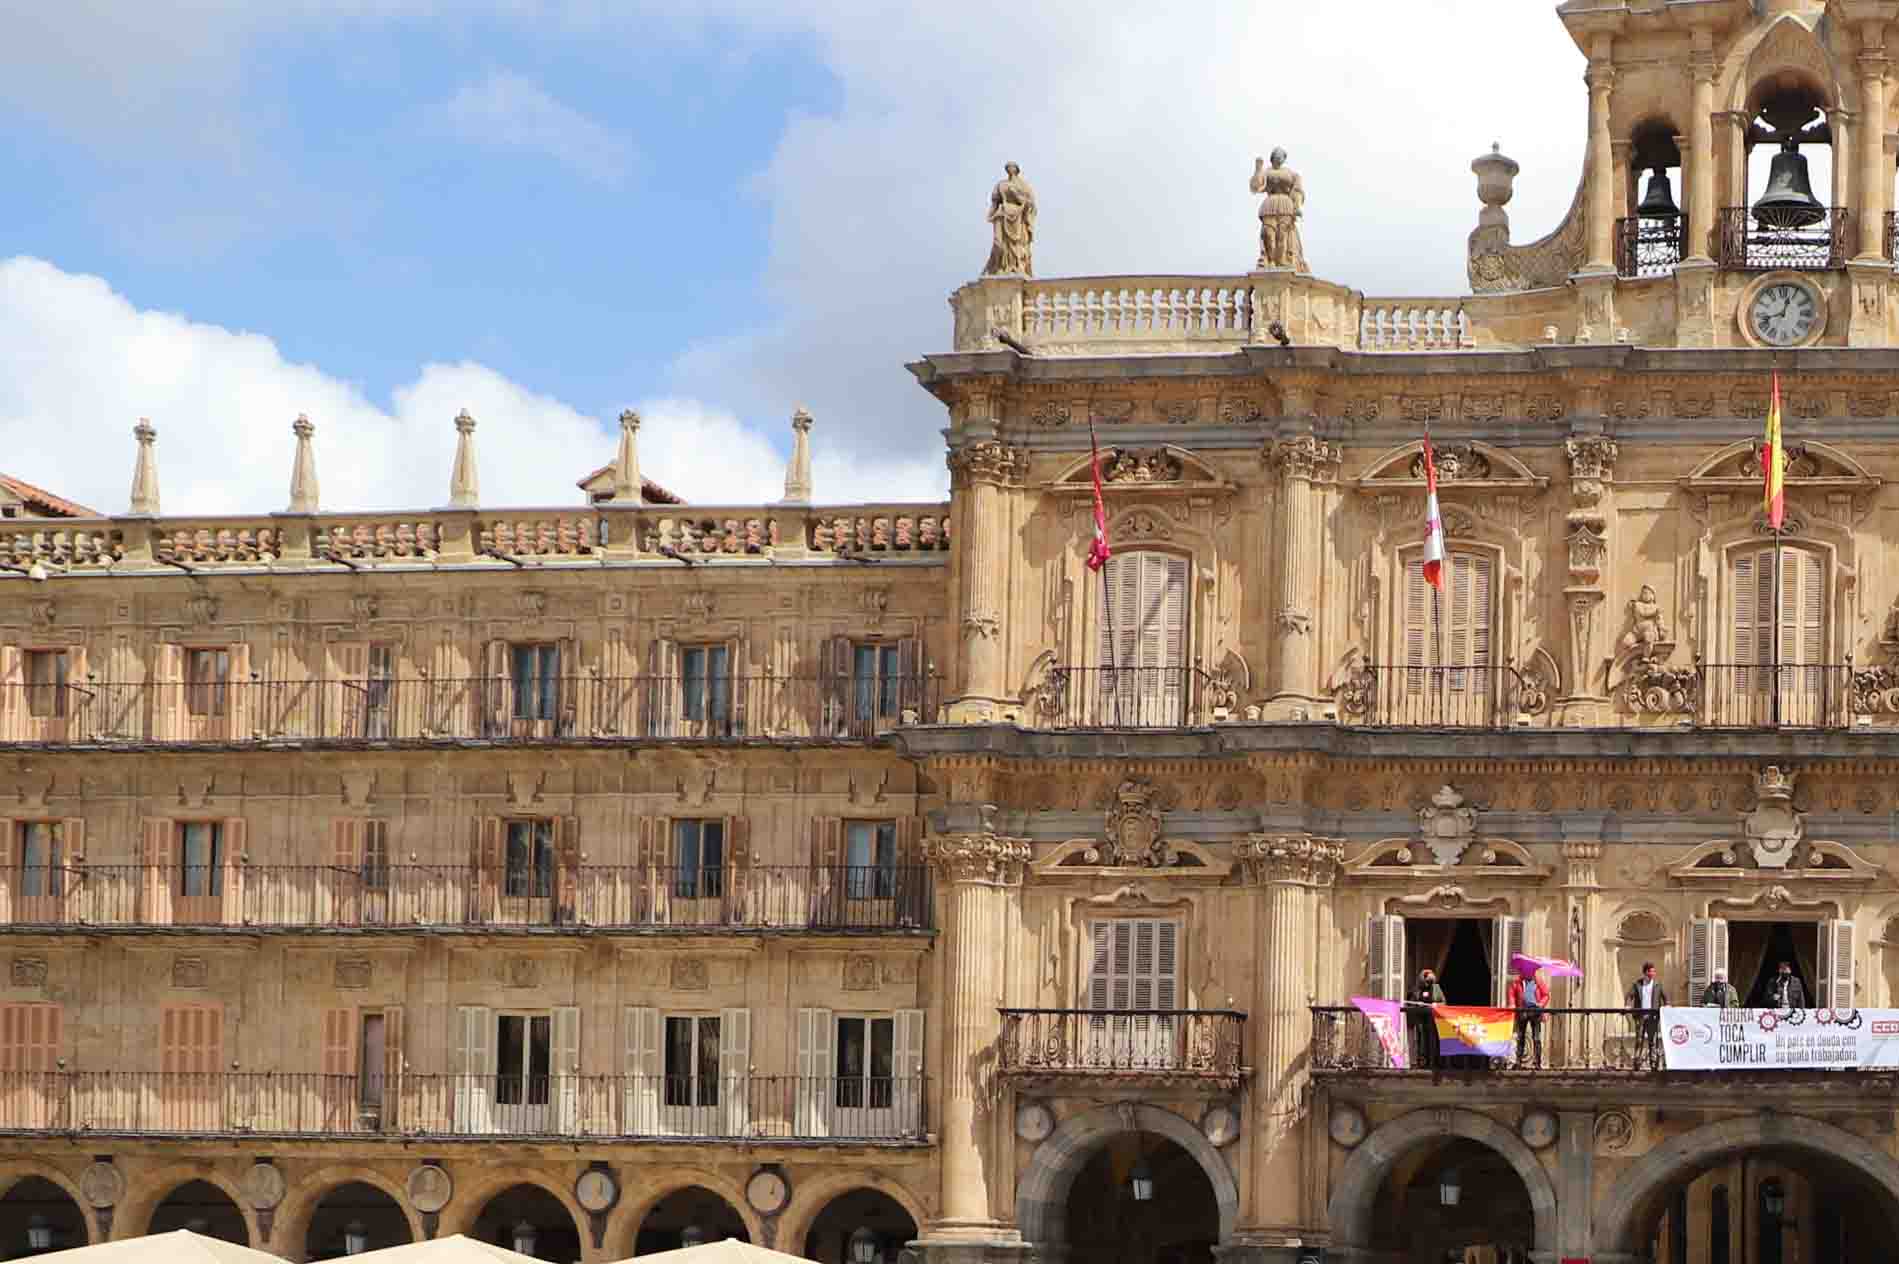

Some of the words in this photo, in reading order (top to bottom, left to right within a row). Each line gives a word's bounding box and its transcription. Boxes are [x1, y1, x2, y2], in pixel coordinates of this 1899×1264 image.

[1720, 1008, 1754, 1023] AHORA
[1720, 1023, 1745, 1042] TOCA
[1818, 1033, 1840, 1047] deuda
[1719, 1043, 1766, 1064] CUMPLIR
[1811, 1048, 1857, 1063] trabajadora
